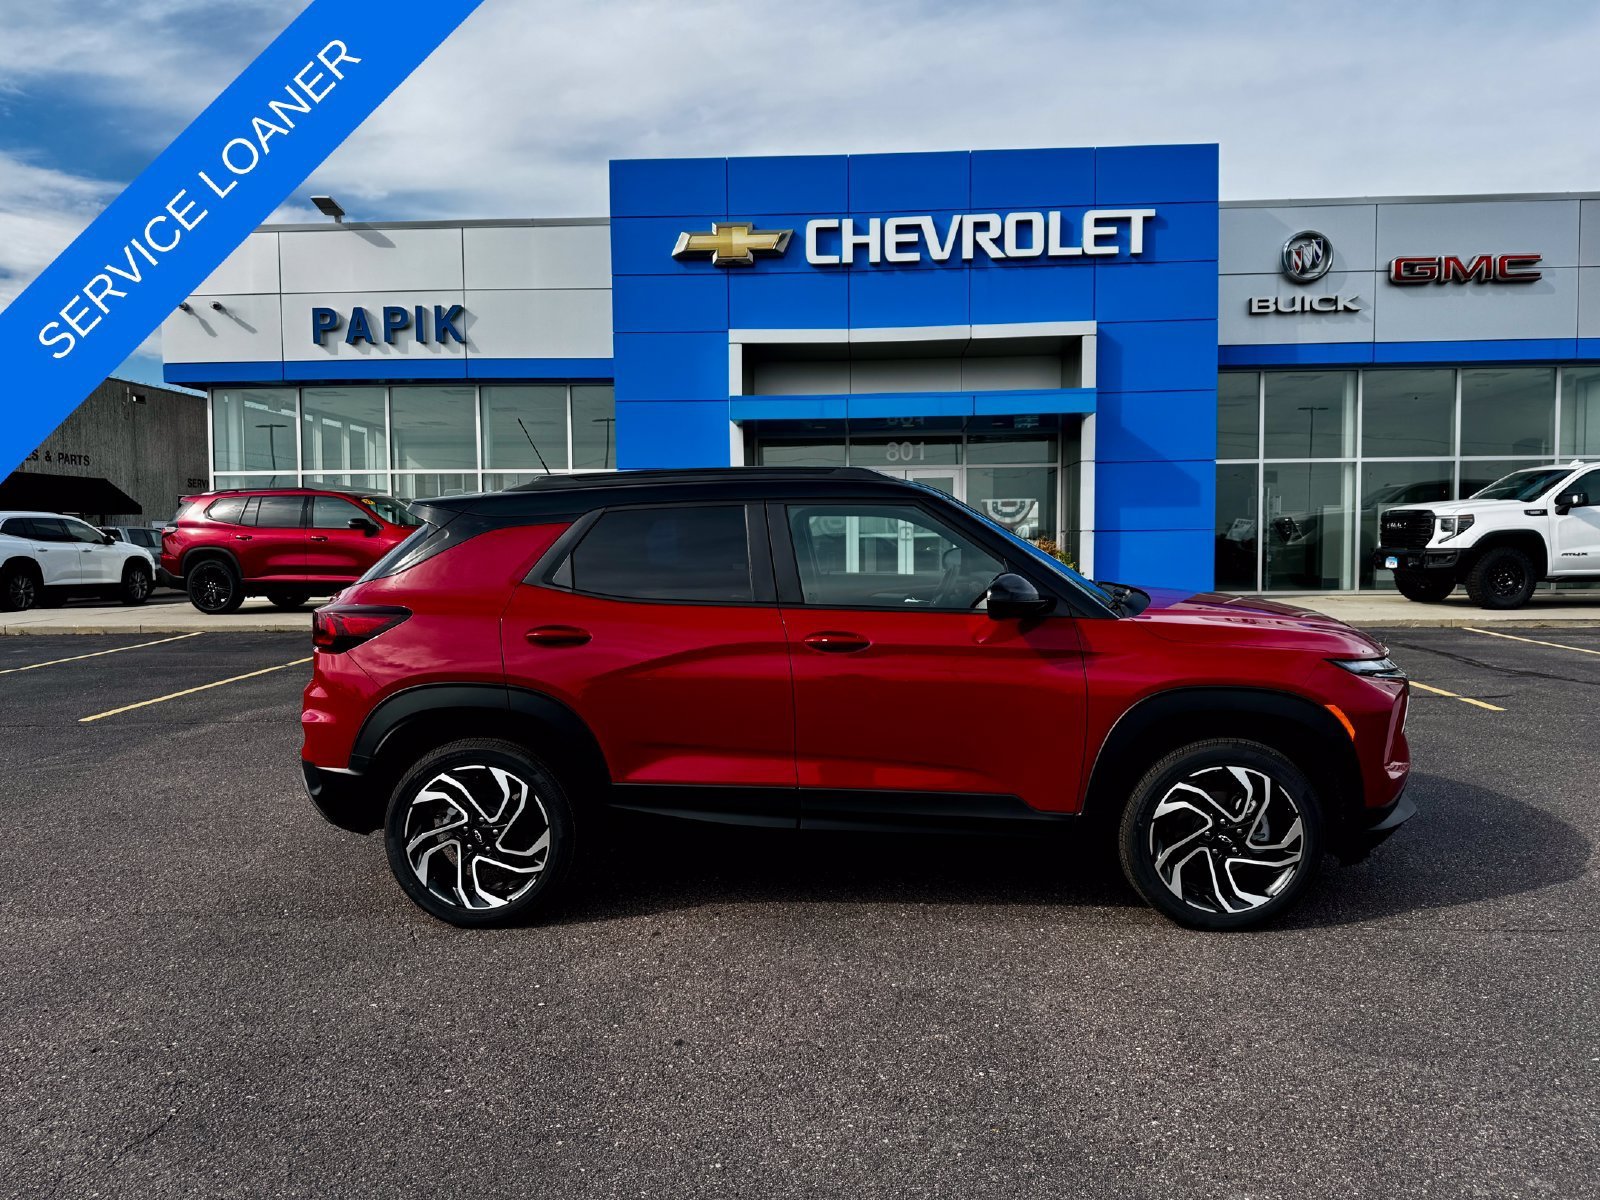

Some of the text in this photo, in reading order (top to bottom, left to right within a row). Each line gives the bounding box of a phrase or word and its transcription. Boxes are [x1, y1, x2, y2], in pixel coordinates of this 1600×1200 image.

[805, 208, 1156, 265] CHEVROLET
[1390, 253, 1543, 284] GMC
[1249, 295, 1362, 314] BUICK
[311, 304, 466, 345] PAPIK
[44, 450, 52, 463] &
[57, 452, 90, 466] PARTS
[886, 441, 925, 461] 801
